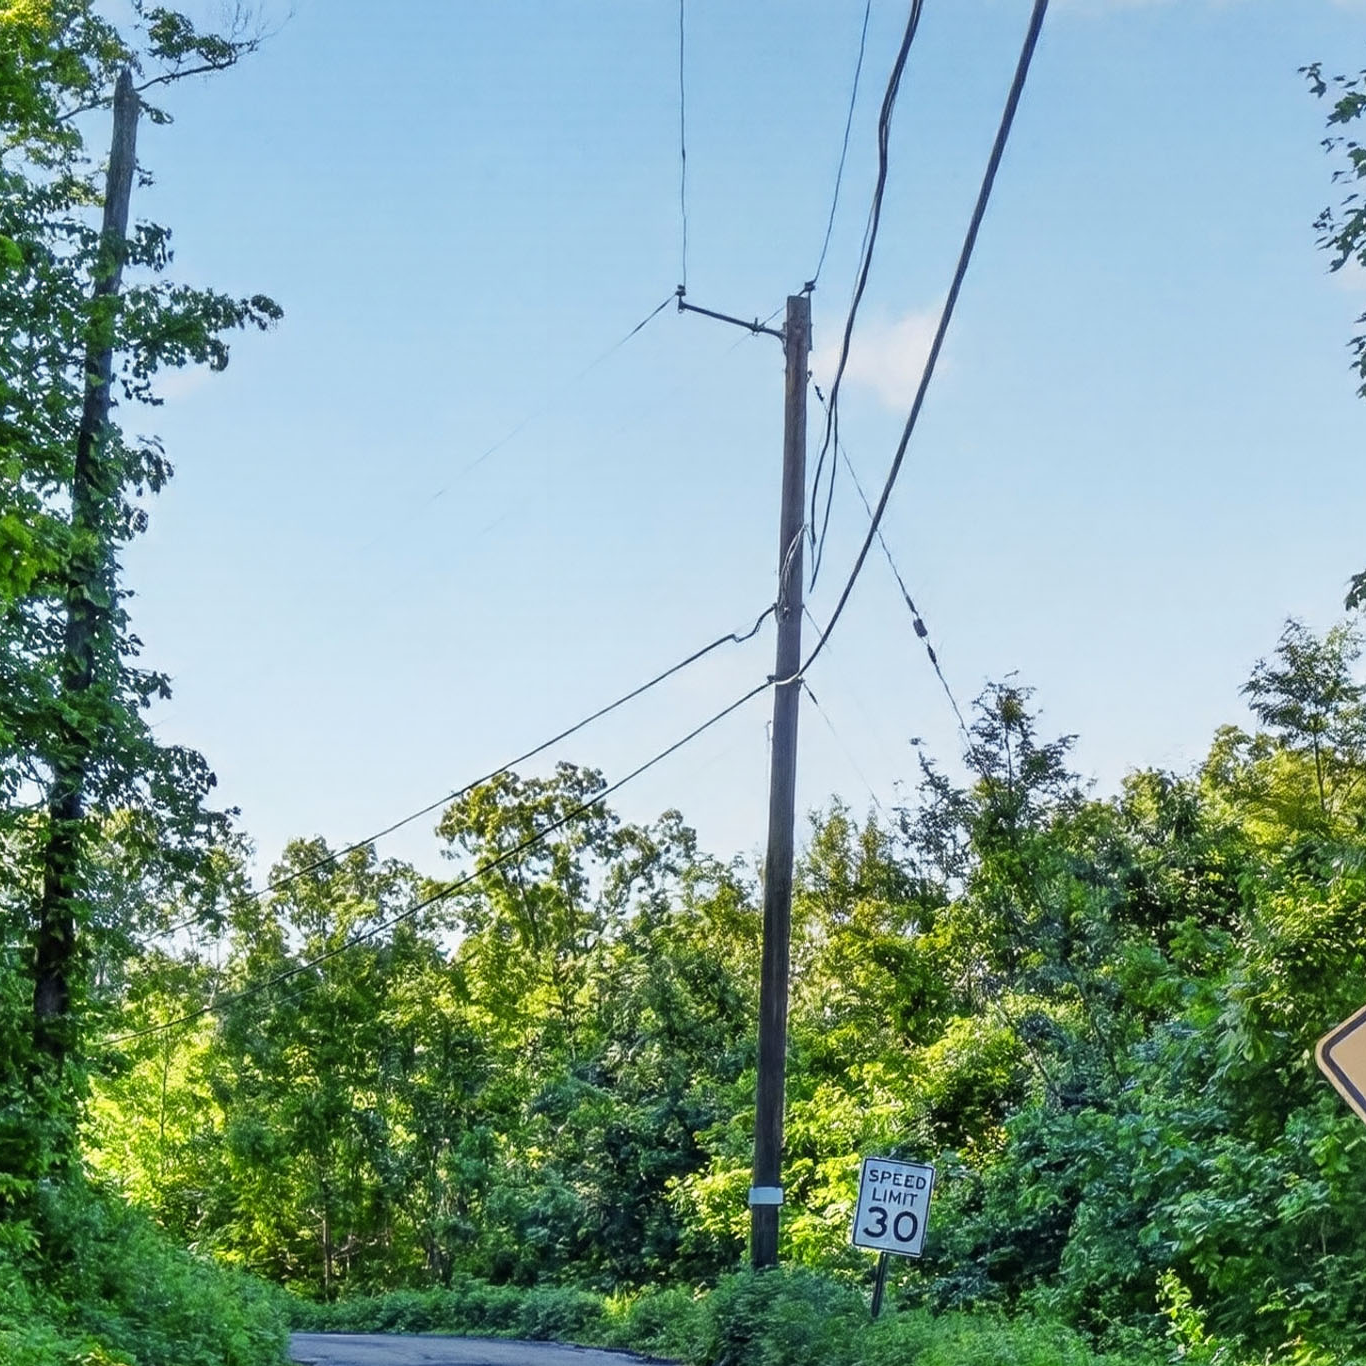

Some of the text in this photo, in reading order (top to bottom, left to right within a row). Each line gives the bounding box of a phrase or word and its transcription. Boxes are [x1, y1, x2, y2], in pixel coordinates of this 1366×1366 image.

[869, 1170, 926, 1189] SPEED
[872, 1188, 918, 1206] LIMIT
[863, 1207, 918, 1242] 30
